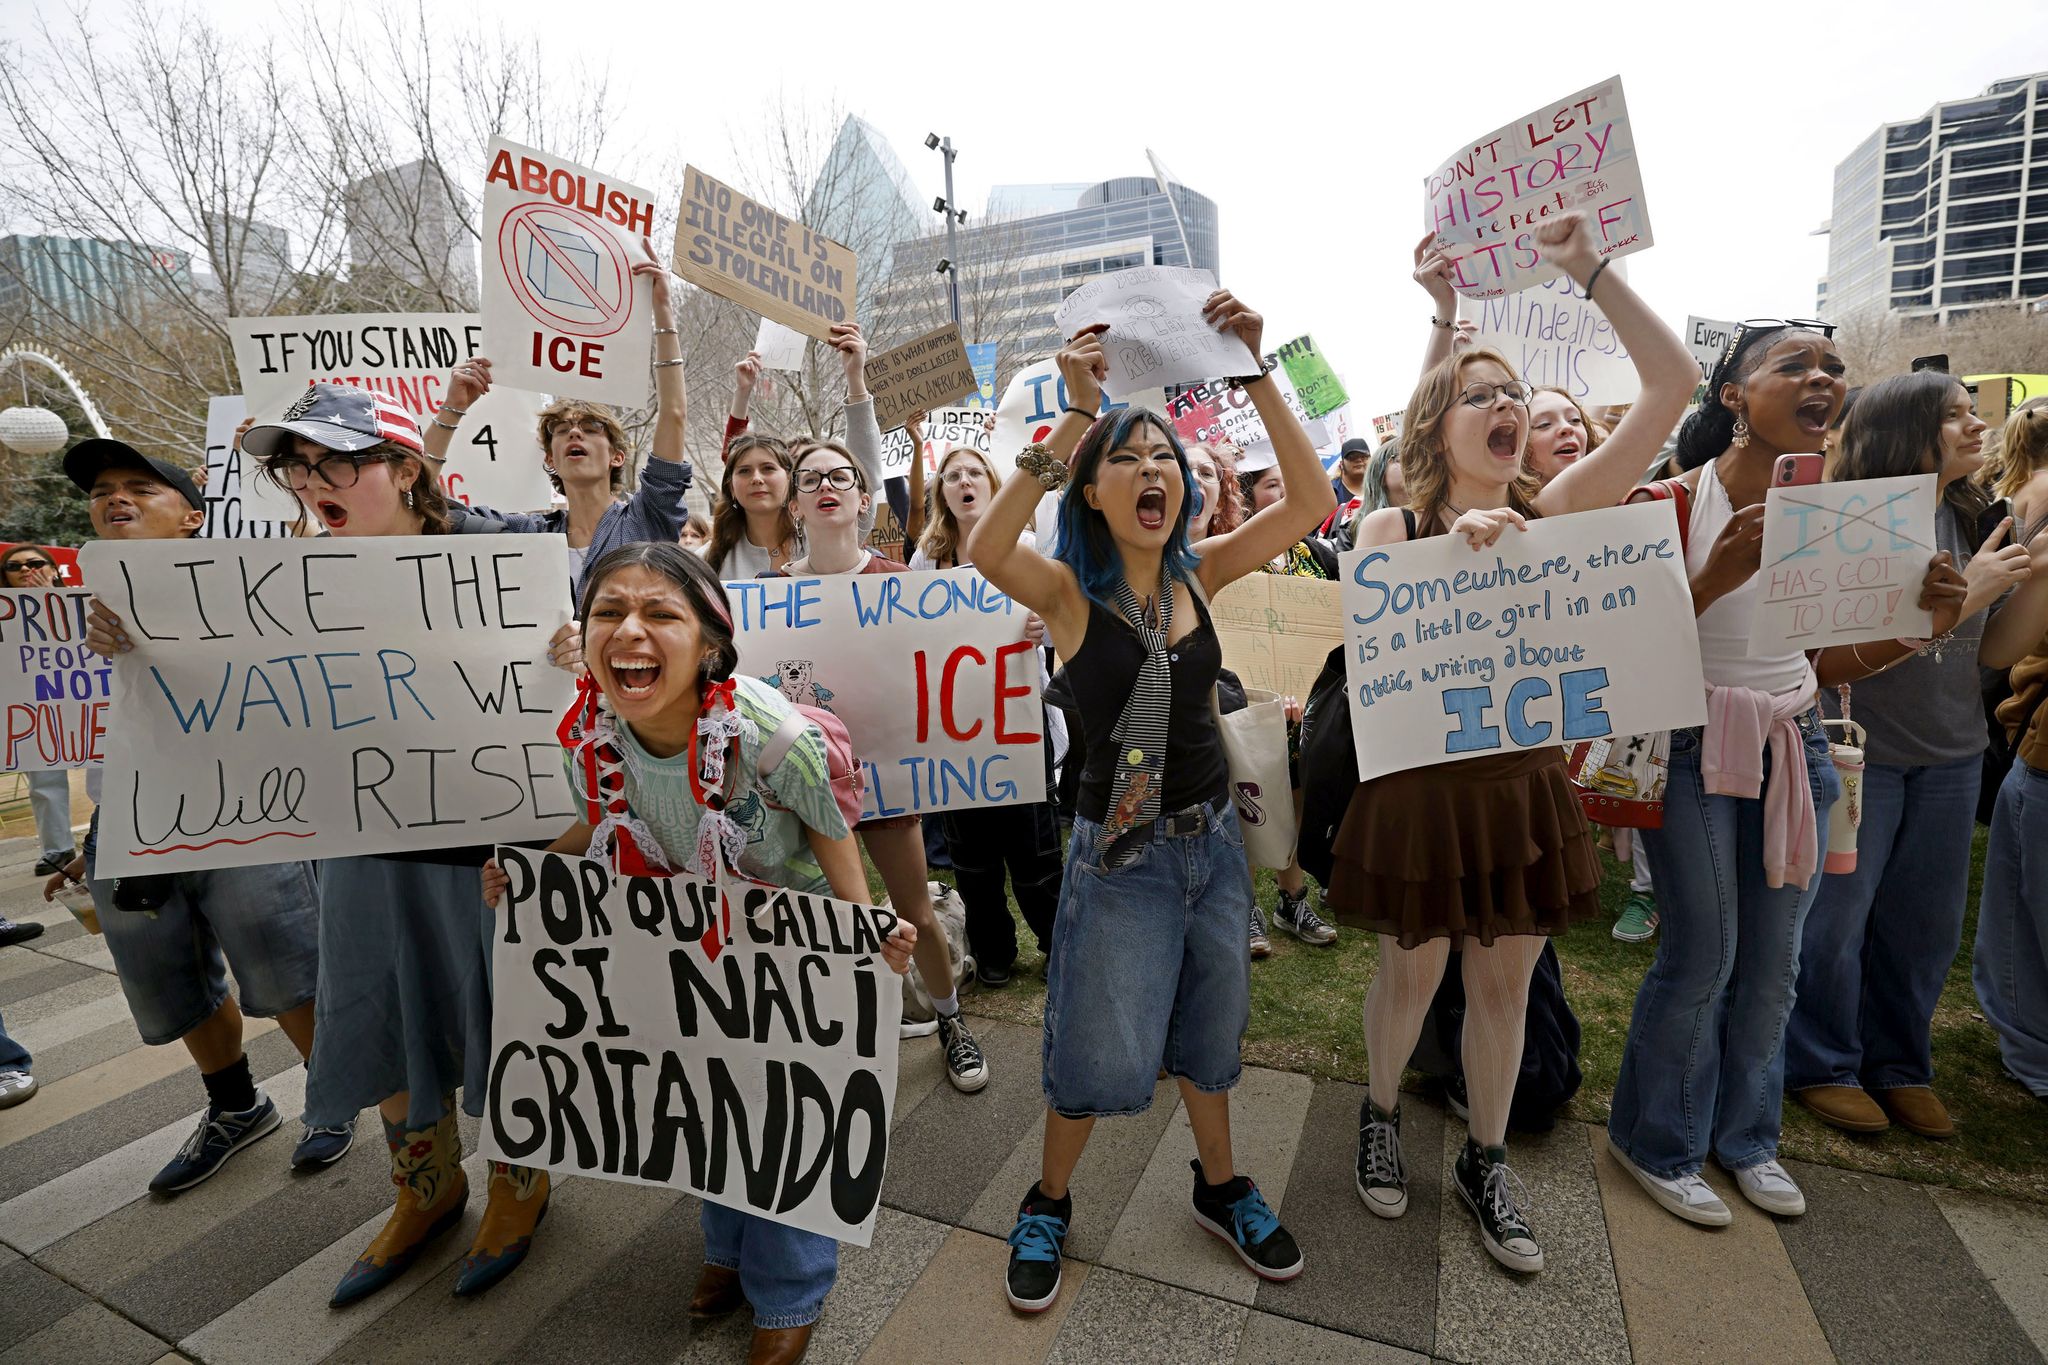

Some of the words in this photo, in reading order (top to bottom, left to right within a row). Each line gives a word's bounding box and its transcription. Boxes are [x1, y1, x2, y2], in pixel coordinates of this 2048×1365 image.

[1430, 138, 1501, 200] DON'T
[1527, 97, 1597, 148] LET
[1435, 123, 1612, 234] HISTORY
[487, 149, 654, 238] ABOLISH
[694, 173, 731, 213] NO
[741, 201, 789, 244] ONE
[803, 230, 828, 261] IS
[1477, 192, 1566, 238] repeat
[685, 200, 801, 274] ILLEGAL
[810, 261, 842, 292] ON
[1451, 198, 1632, 288] ITSF
[689, 234, 789, 301] STOLEN
[793, 280, 846, 322] LAND
[251, 333, 299, 373] IF
[302, 329, 352, 371] YOU
[361, 326, 457, 368] STAND
[532, 332, 605, 379] ICE
[864, 359, 888, 378] THIS
[891, 353, 901, 367] IS
[901, 342, 926, 361] WHAT
[927, 331, 957, 349] HAPPENS
[1481, 291, 1628, 359] Mindednes
[882, 385, 927, 418] BLACK
[925, 368, 975, 399] AMERICANS
[889, 372, 904, 383] YOU
[930, 348, 959, 369] LISTEN
[472, 425, 497, 461] 4
[923, 424, 990, 452] JUSTIC
[1780, 493, 1915, 560] ICE
[120, 553, 364, 641] LIKE
[396, 553, 537, 630] THE
[726, 579, 821, 631] THE
[852, 576, 1013, 628] WRONG
[1353, 552, 1580, 625] Somewhere,
[1587, 537, 1674, 569] there
[1769, 567, 1827, 599] HAS
[1837, 556, 1900, 588] GOT
[1790, 603, 1823, 632] TO
[1833, 588, 1904, 626] GO!
[0, 592, 93, 643] PROT
[1358, 634, 1379, 664] is
[1391, 631, 1406, 651] a
[1415, 609, 1492, 643] little
[1496, 590, 1551, 638] girl
[1566, 597, 1589, 617] in
[1602, 584, 1636, 611] an
[35, 668, 112, 701] NOT
[150, 649, 435, 733] WATER
[454, 661, 552, 714] WE
[914, 641, 1041, 744] ICE
[1421, 655, 1495, 682] writing
[1504, 638, 1585, 668] about
[6, 702, 110, 770] POWE
[1441, 667, 1612, 753] ICE
[133, 760, 308, 846] Will
[352, 743, 577, 832] RISE
[860, 754, 1017, 819] ELTING
[499, 847, 613, 945] POR
[533, 947, 630, 1039] SI
[669, 947, 877, 1057] NACÍ
[489, 1040, 886, 1225] GRITANDO
